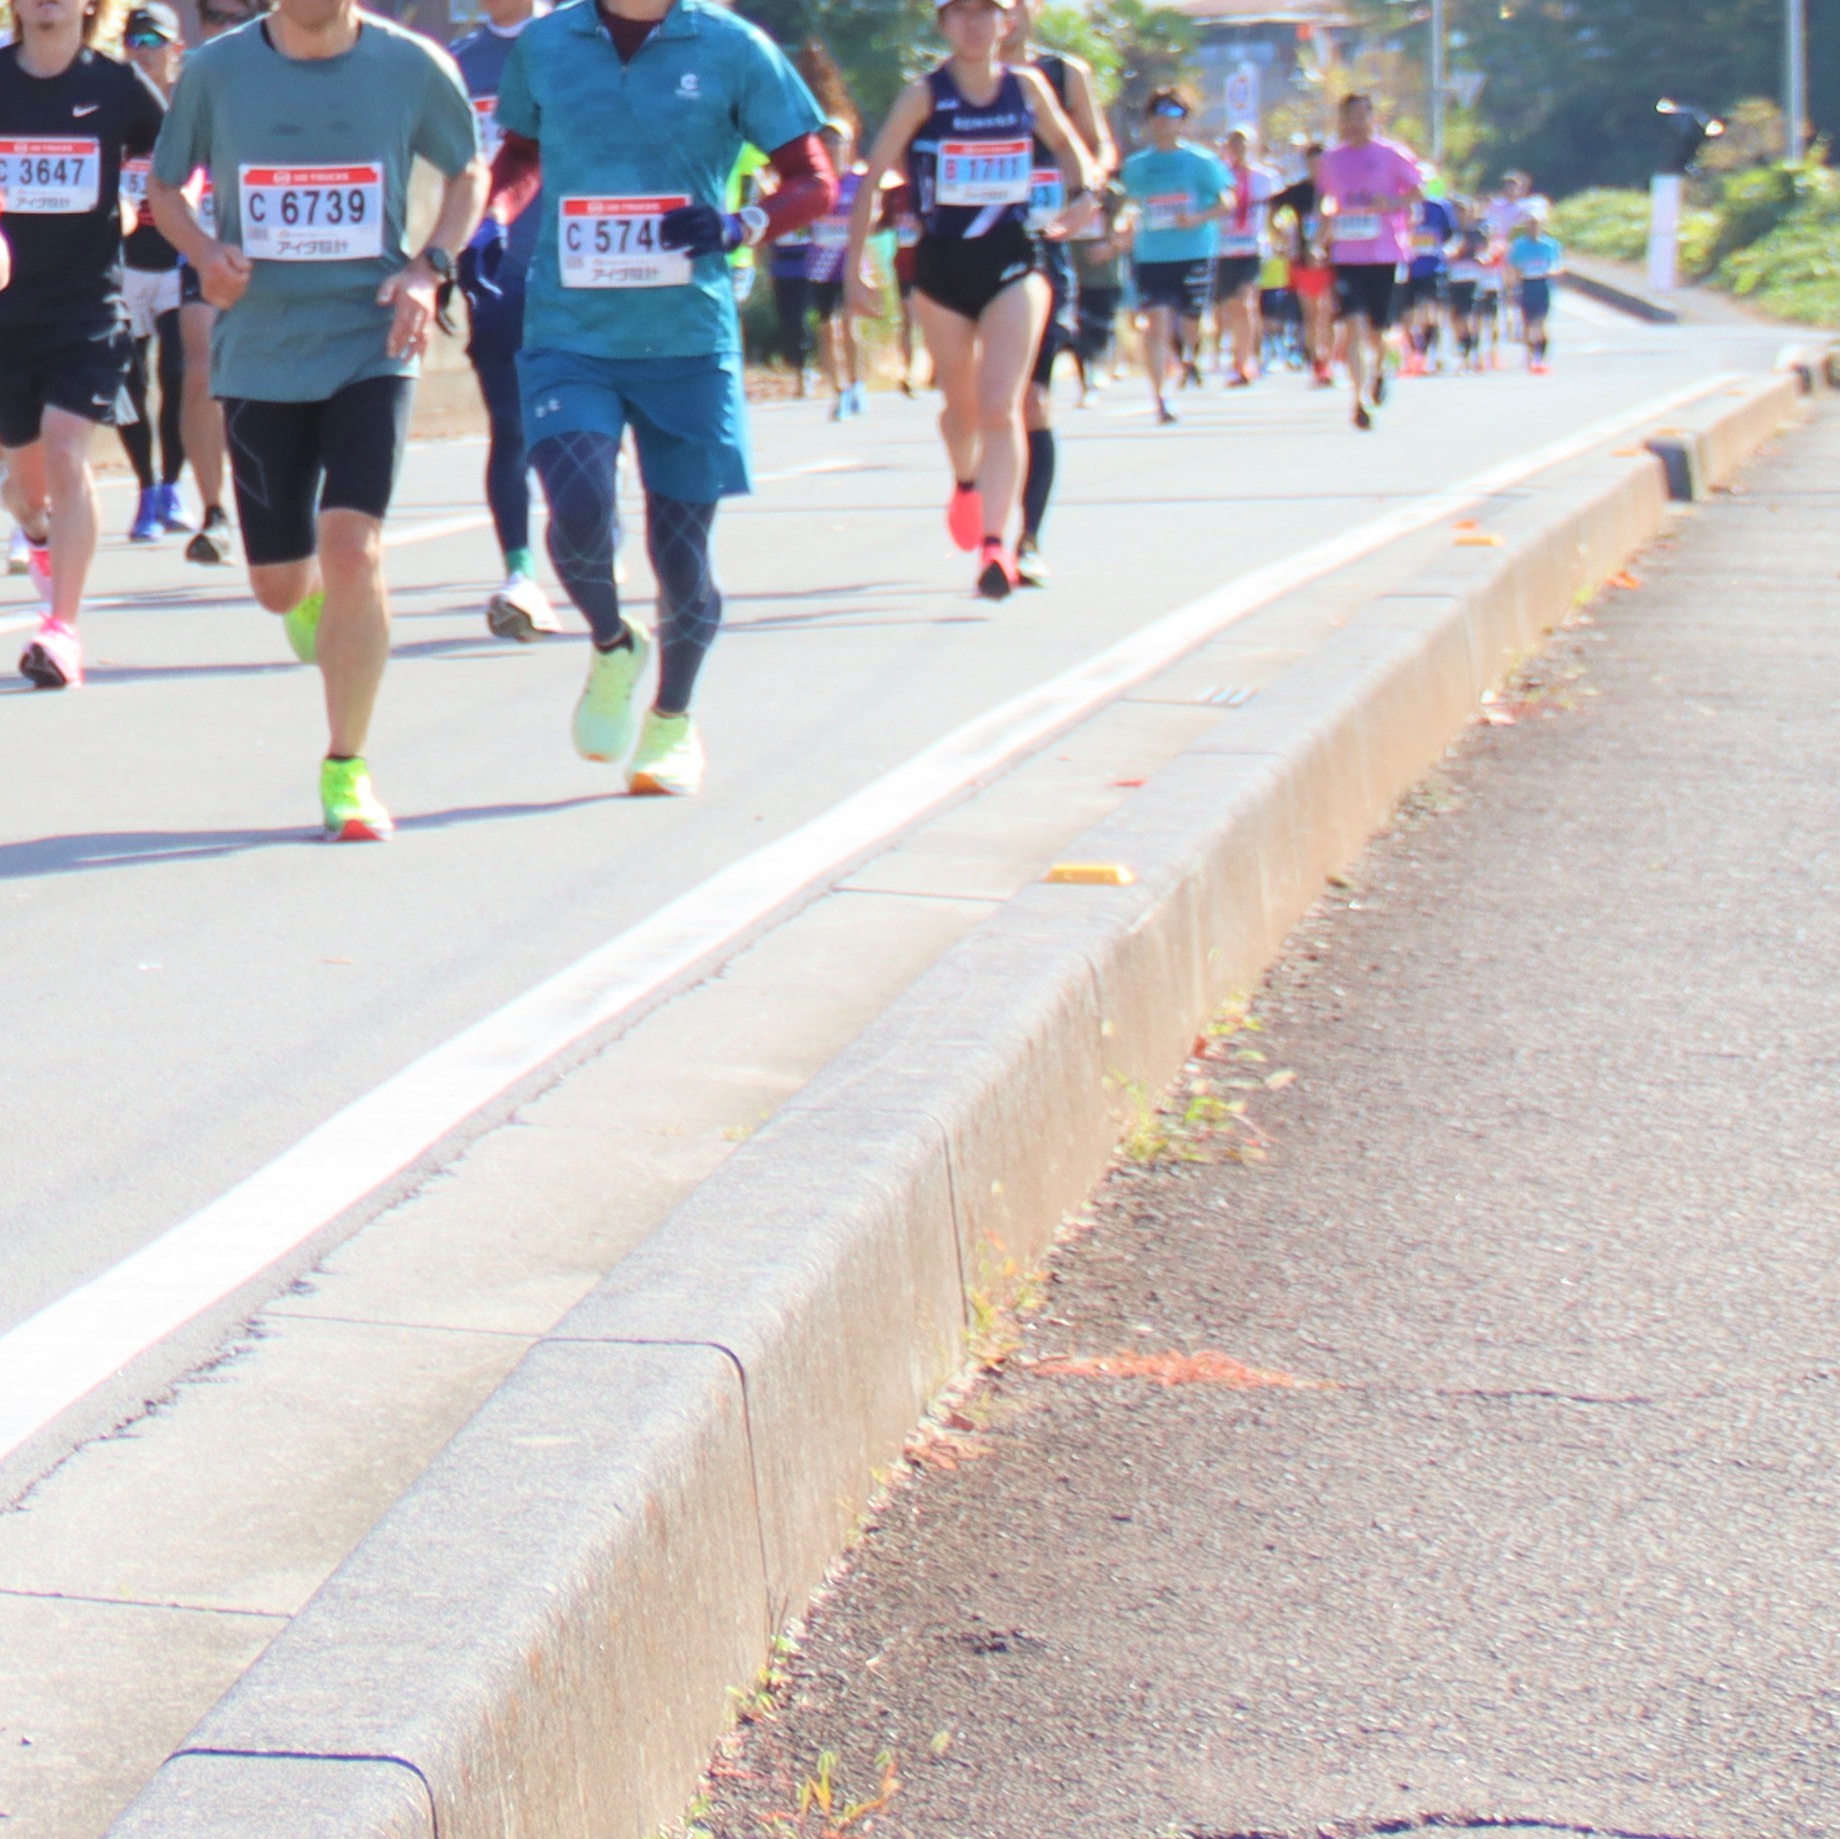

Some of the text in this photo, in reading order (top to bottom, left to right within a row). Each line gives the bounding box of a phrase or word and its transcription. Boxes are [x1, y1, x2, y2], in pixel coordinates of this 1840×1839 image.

[19, 159, 84, 185] 3647
[249, 192, 266, 222] C
[281, 189, 365, 225] 6739
[567, 222, 581, 251] C
